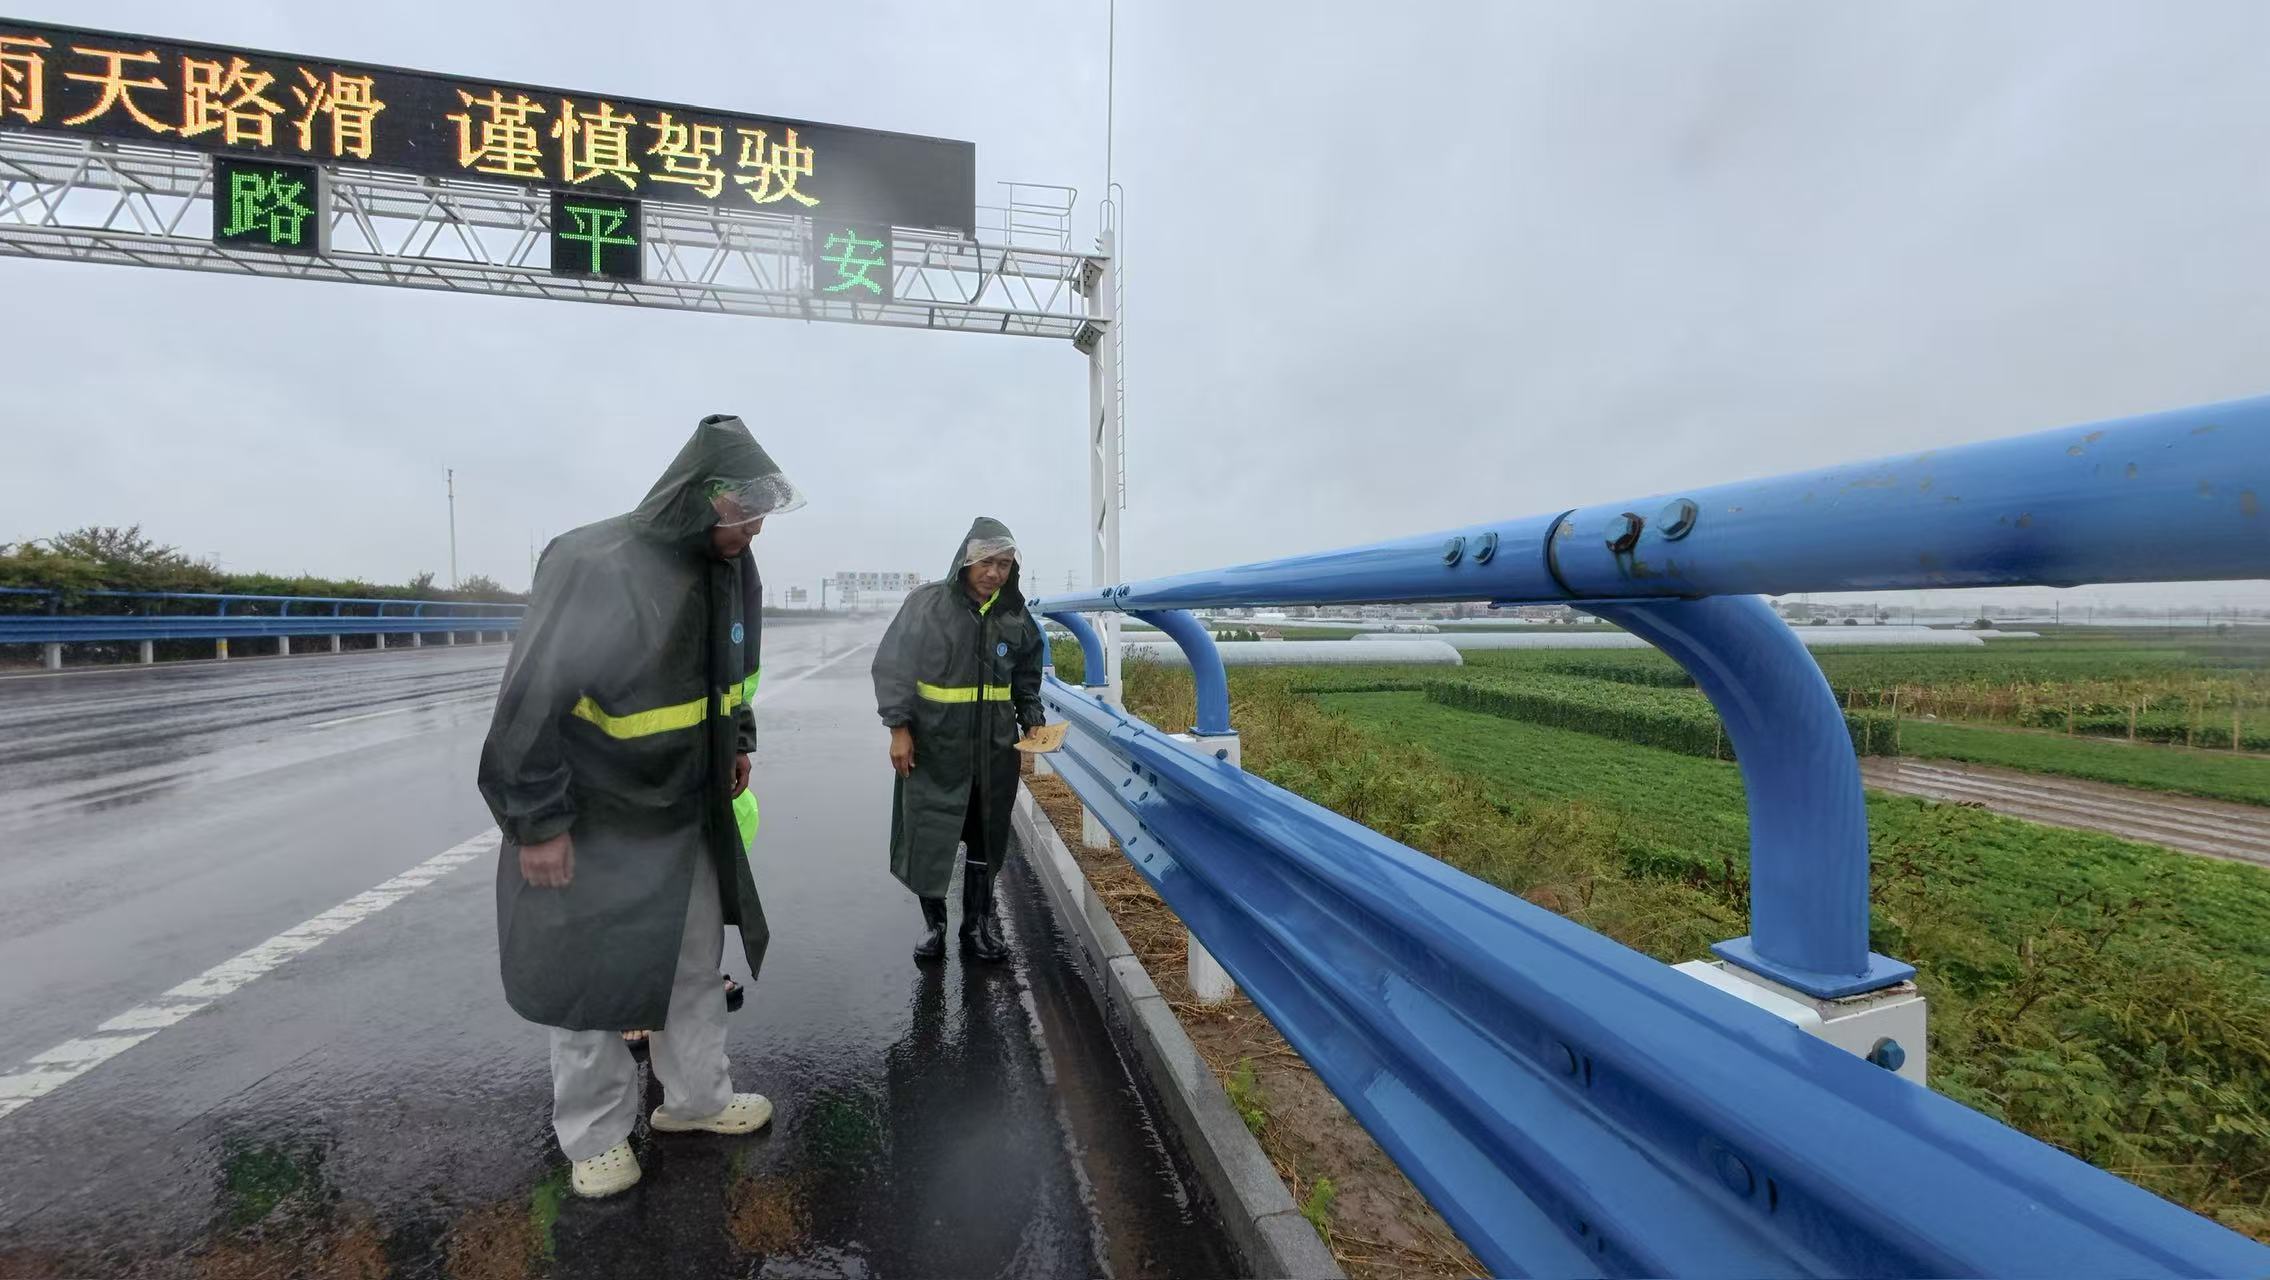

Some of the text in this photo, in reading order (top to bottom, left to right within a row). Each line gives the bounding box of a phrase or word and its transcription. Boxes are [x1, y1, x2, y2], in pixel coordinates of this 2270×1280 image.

[446, 88, 820, 208] 谨慎驾驶
[222, 170, 315, 245] 路
[559, 204, 637, 273] 平
[820, 229, 886, 295] 安
